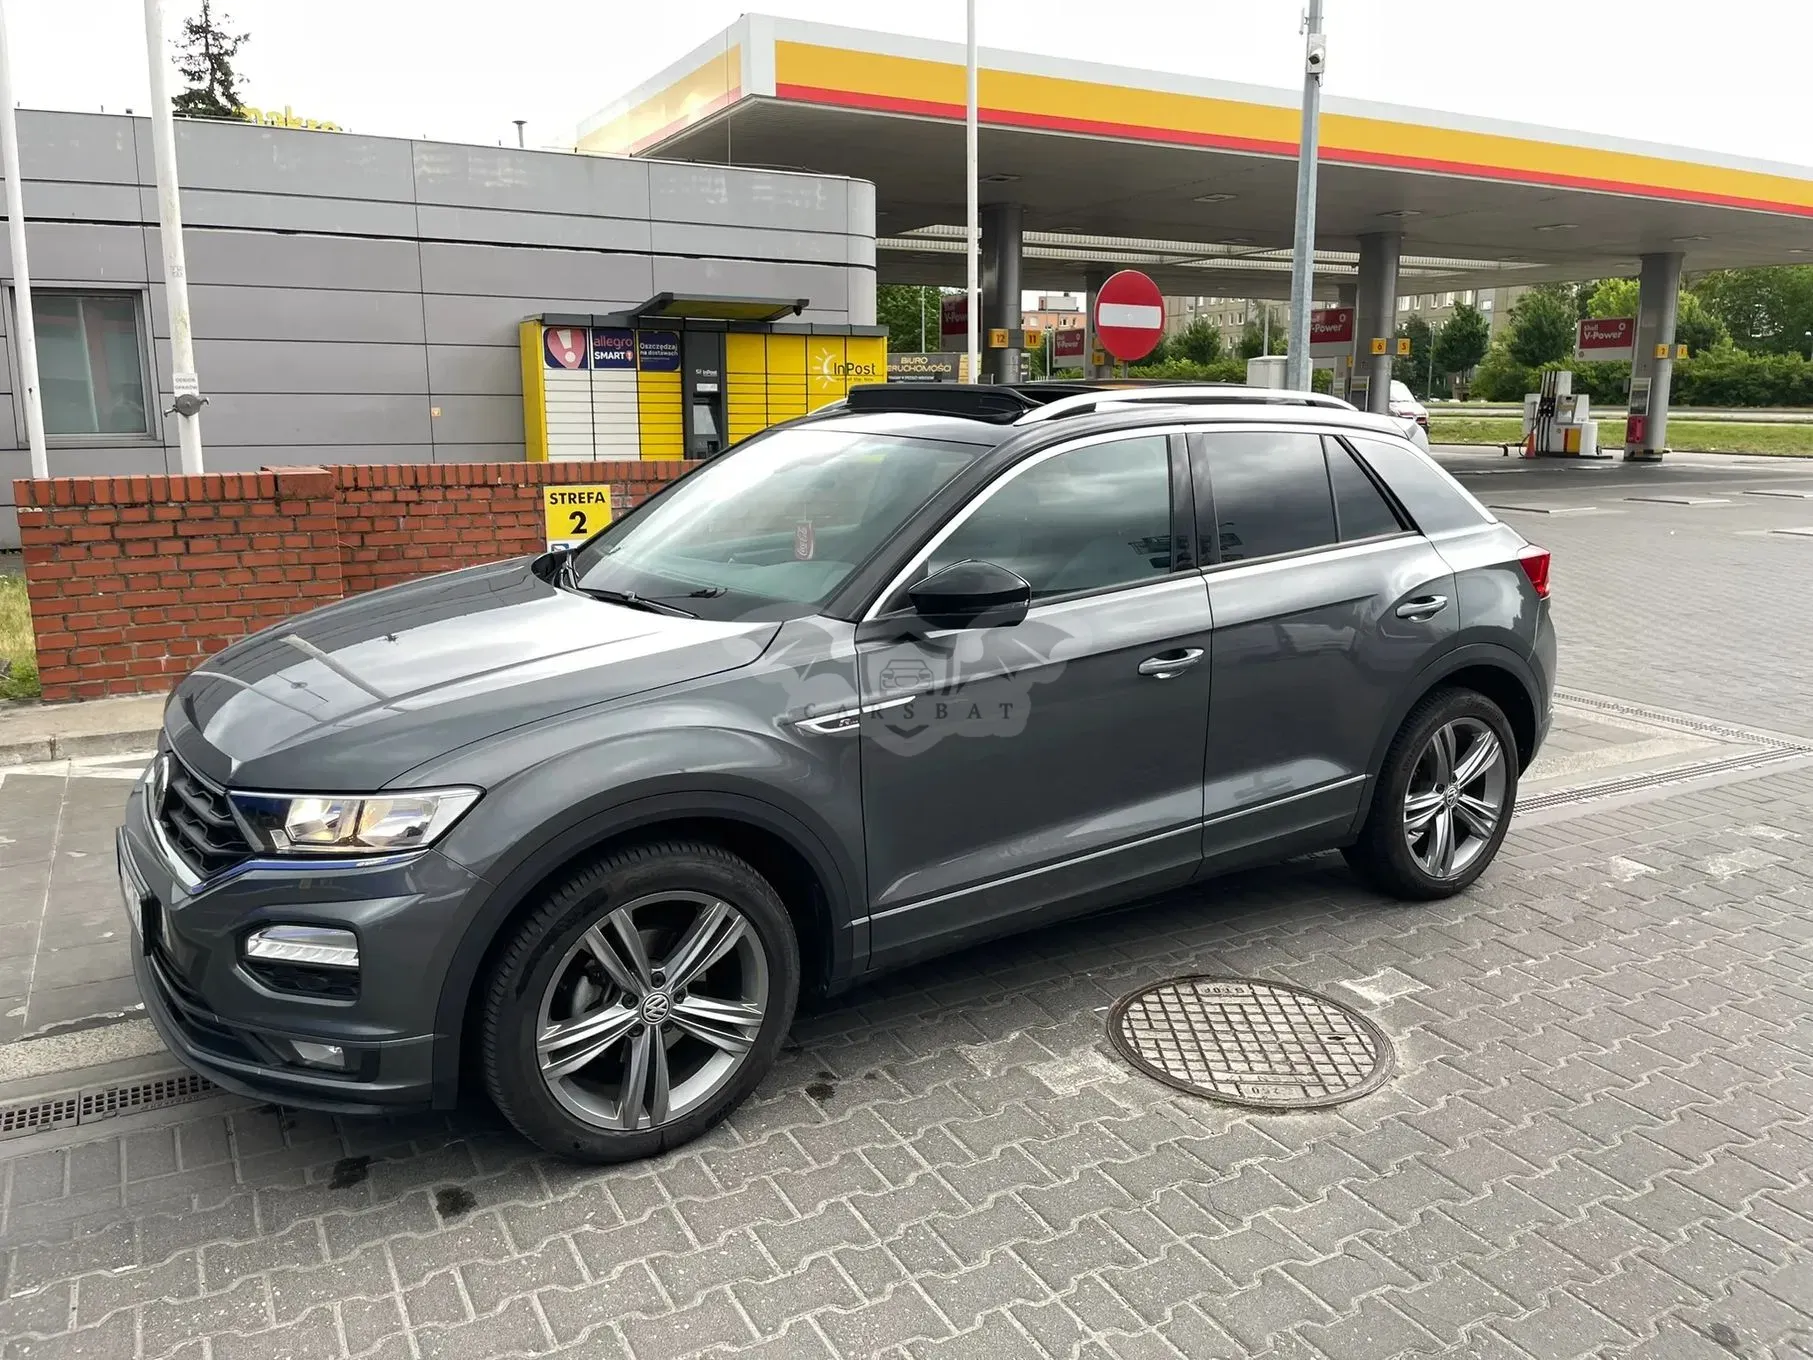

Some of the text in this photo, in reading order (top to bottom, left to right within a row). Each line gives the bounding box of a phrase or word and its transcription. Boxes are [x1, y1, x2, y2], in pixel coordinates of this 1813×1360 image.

[1311, 323, 1343, 333] -Power
[995, 334, 1006, 343] 12
[1029, 334, 1037, 344] 11
[1584, 331, 1622, 340] V-Power
[593, 335, 633, 350] allegro
[640, 342, 678, 352] Oszczędzaj
[1377, 343, 1383, 351] 6
[1401, 342, 1407, 351] 5
[594, 351, 625, 360] SMART
[900, 356, 928, 365] BIURO
[834, 362, 876, 375] InPost
[549, 491, 606, 505] STREFA
[568, 510, 588, 535] 2
